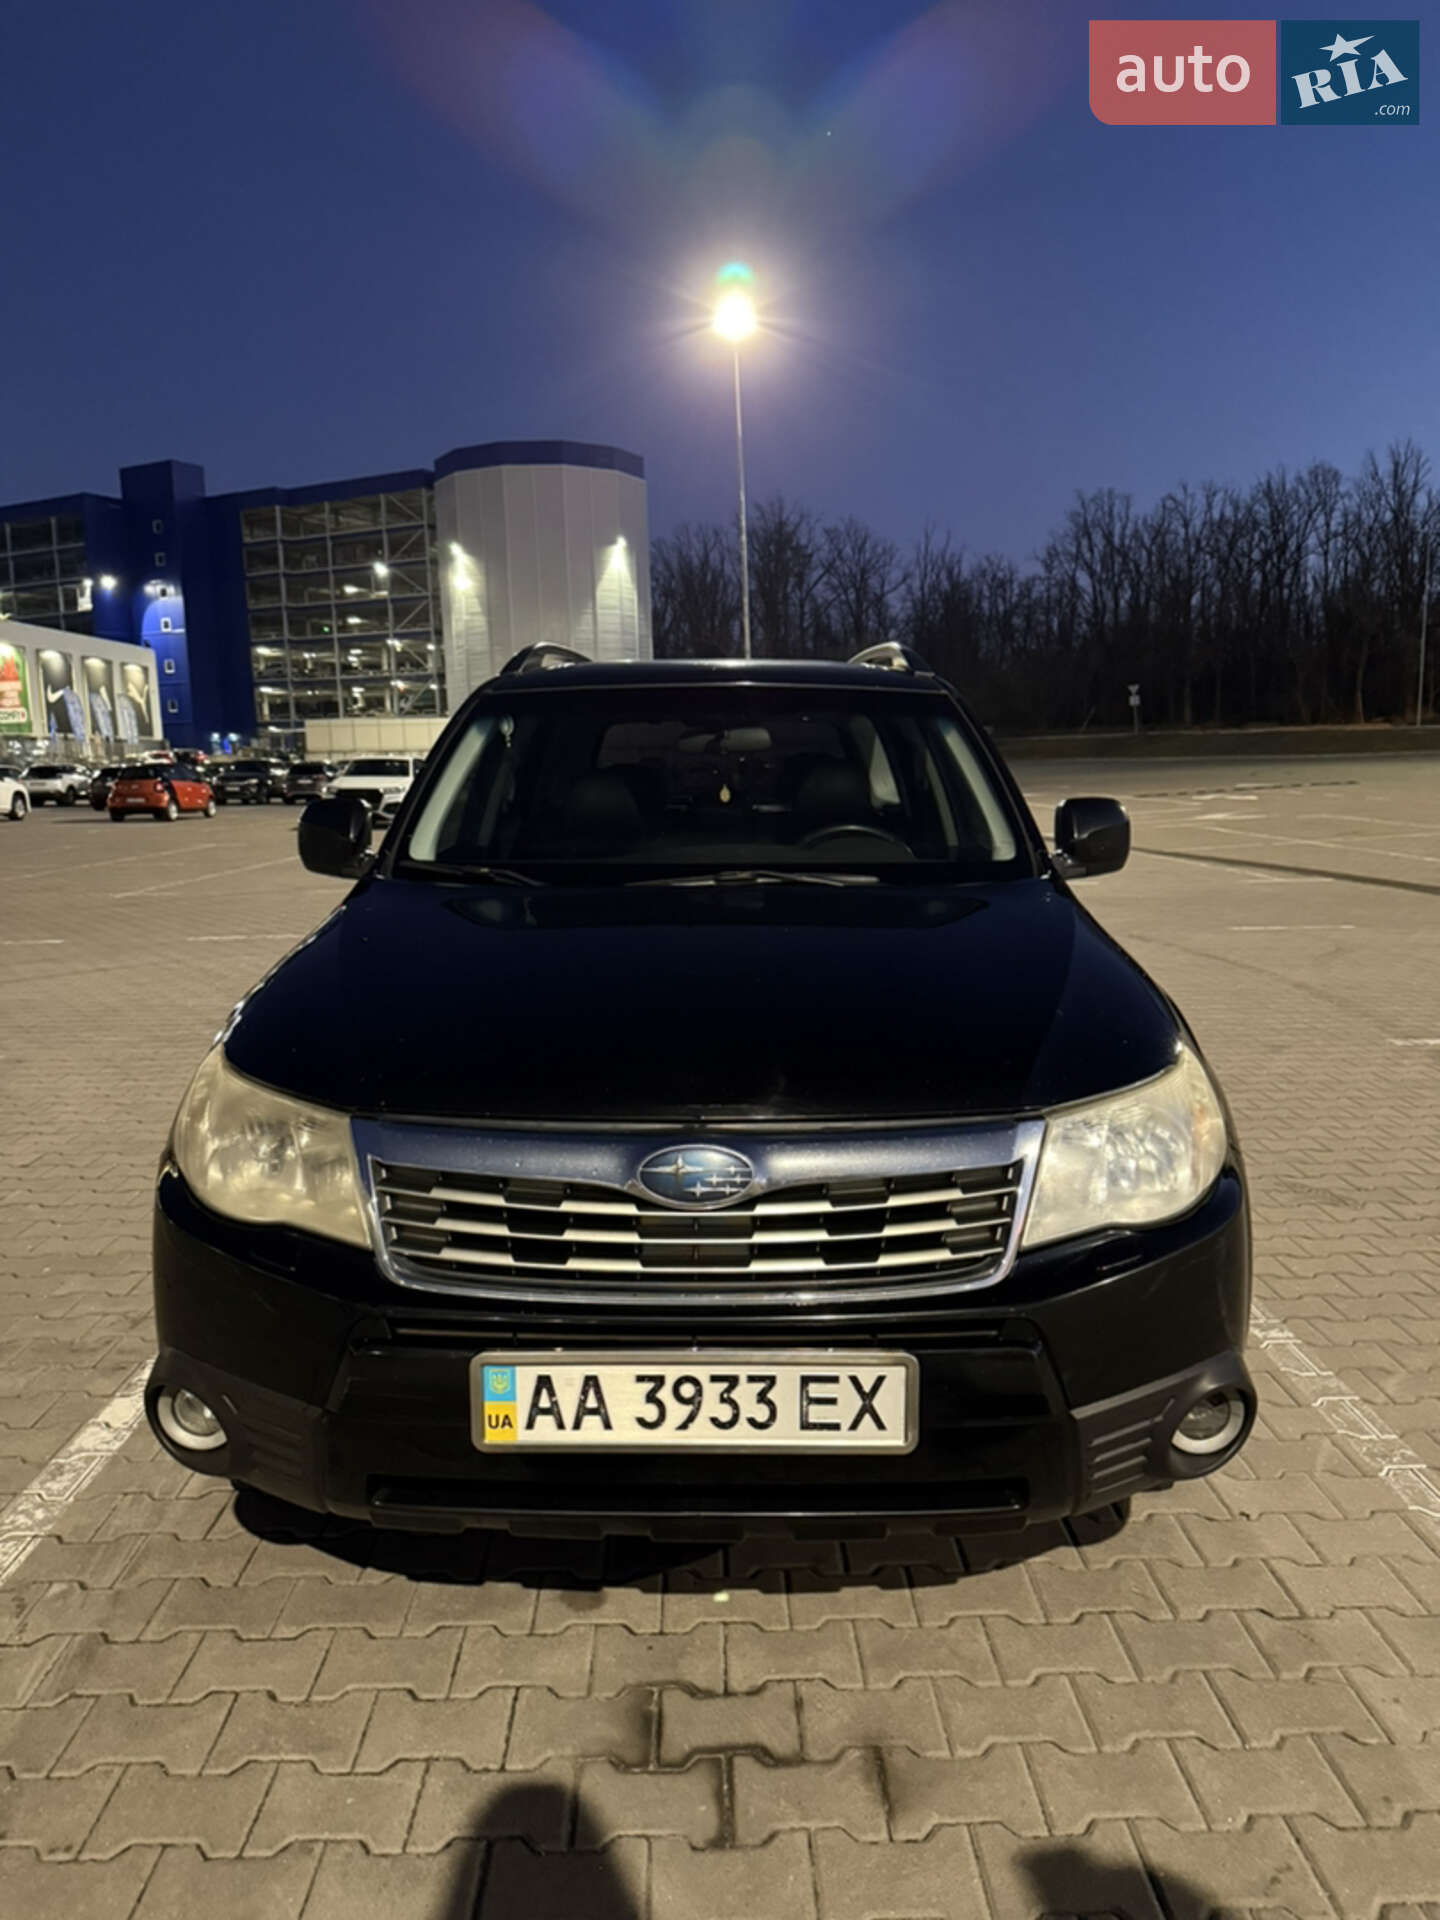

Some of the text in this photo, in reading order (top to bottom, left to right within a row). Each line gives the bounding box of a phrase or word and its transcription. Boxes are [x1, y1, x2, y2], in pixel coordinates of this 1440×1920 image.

[525, 1374, 887, 1431] AA 3933 EX
[488, 1413, 514, 1430] UA
